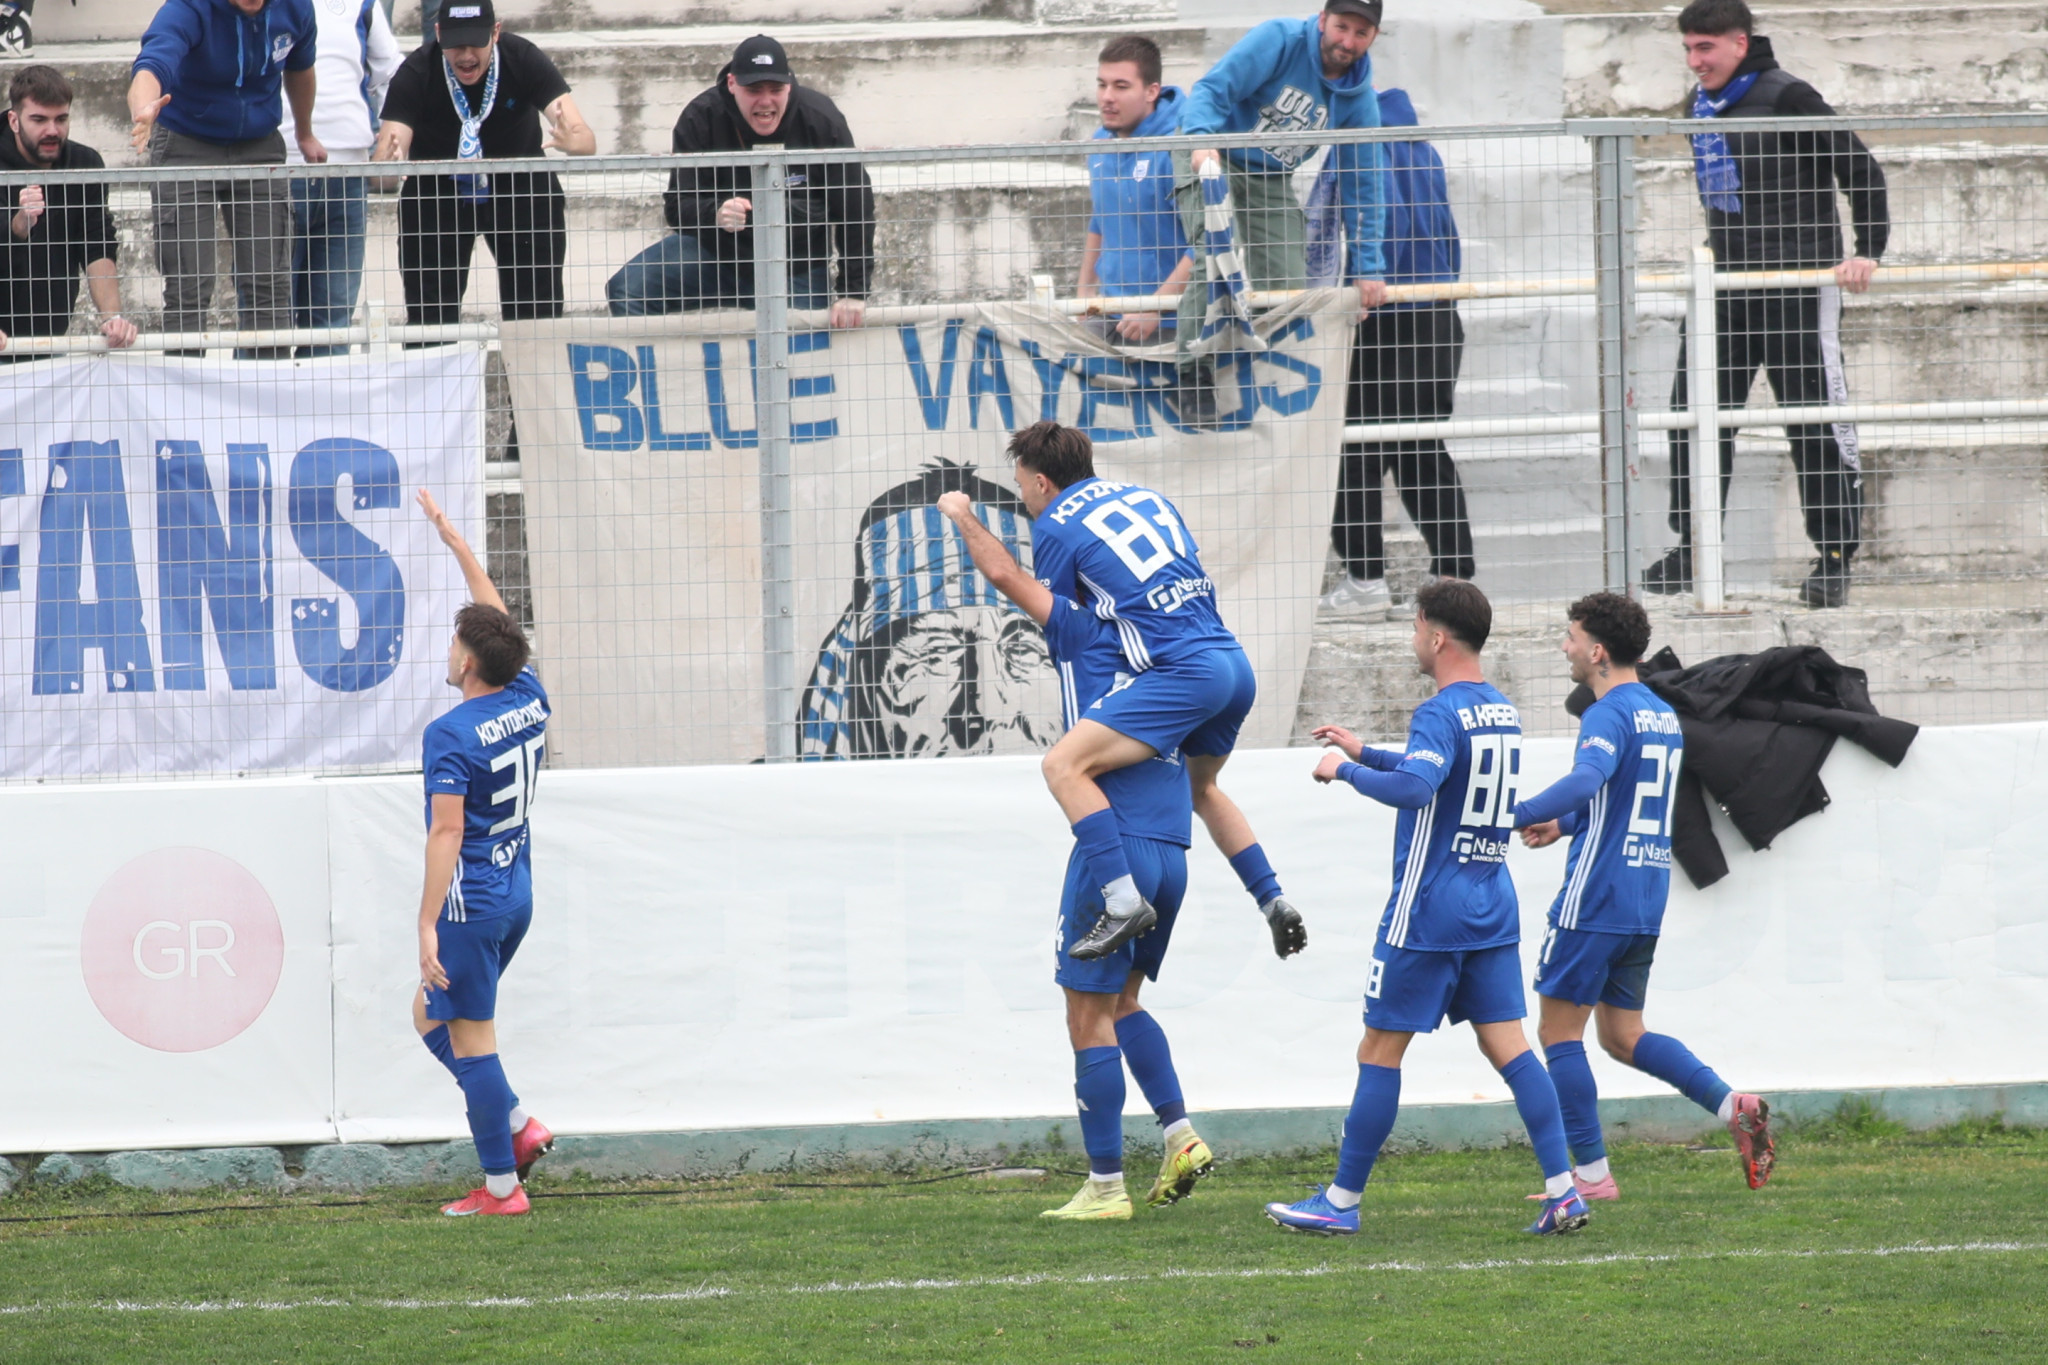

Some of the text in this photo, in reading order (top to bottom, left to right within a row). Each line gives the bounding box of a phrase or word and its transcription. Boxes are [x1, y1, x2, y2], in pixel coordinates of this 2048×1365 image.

[567, 331, 839, 451] BLUE
[0, 437, 406, 695] ANS
[1081, 490, 1187, 583] 87
[1627, 744, 1684, 837] 21
[132, 919, 237, 980] GR
